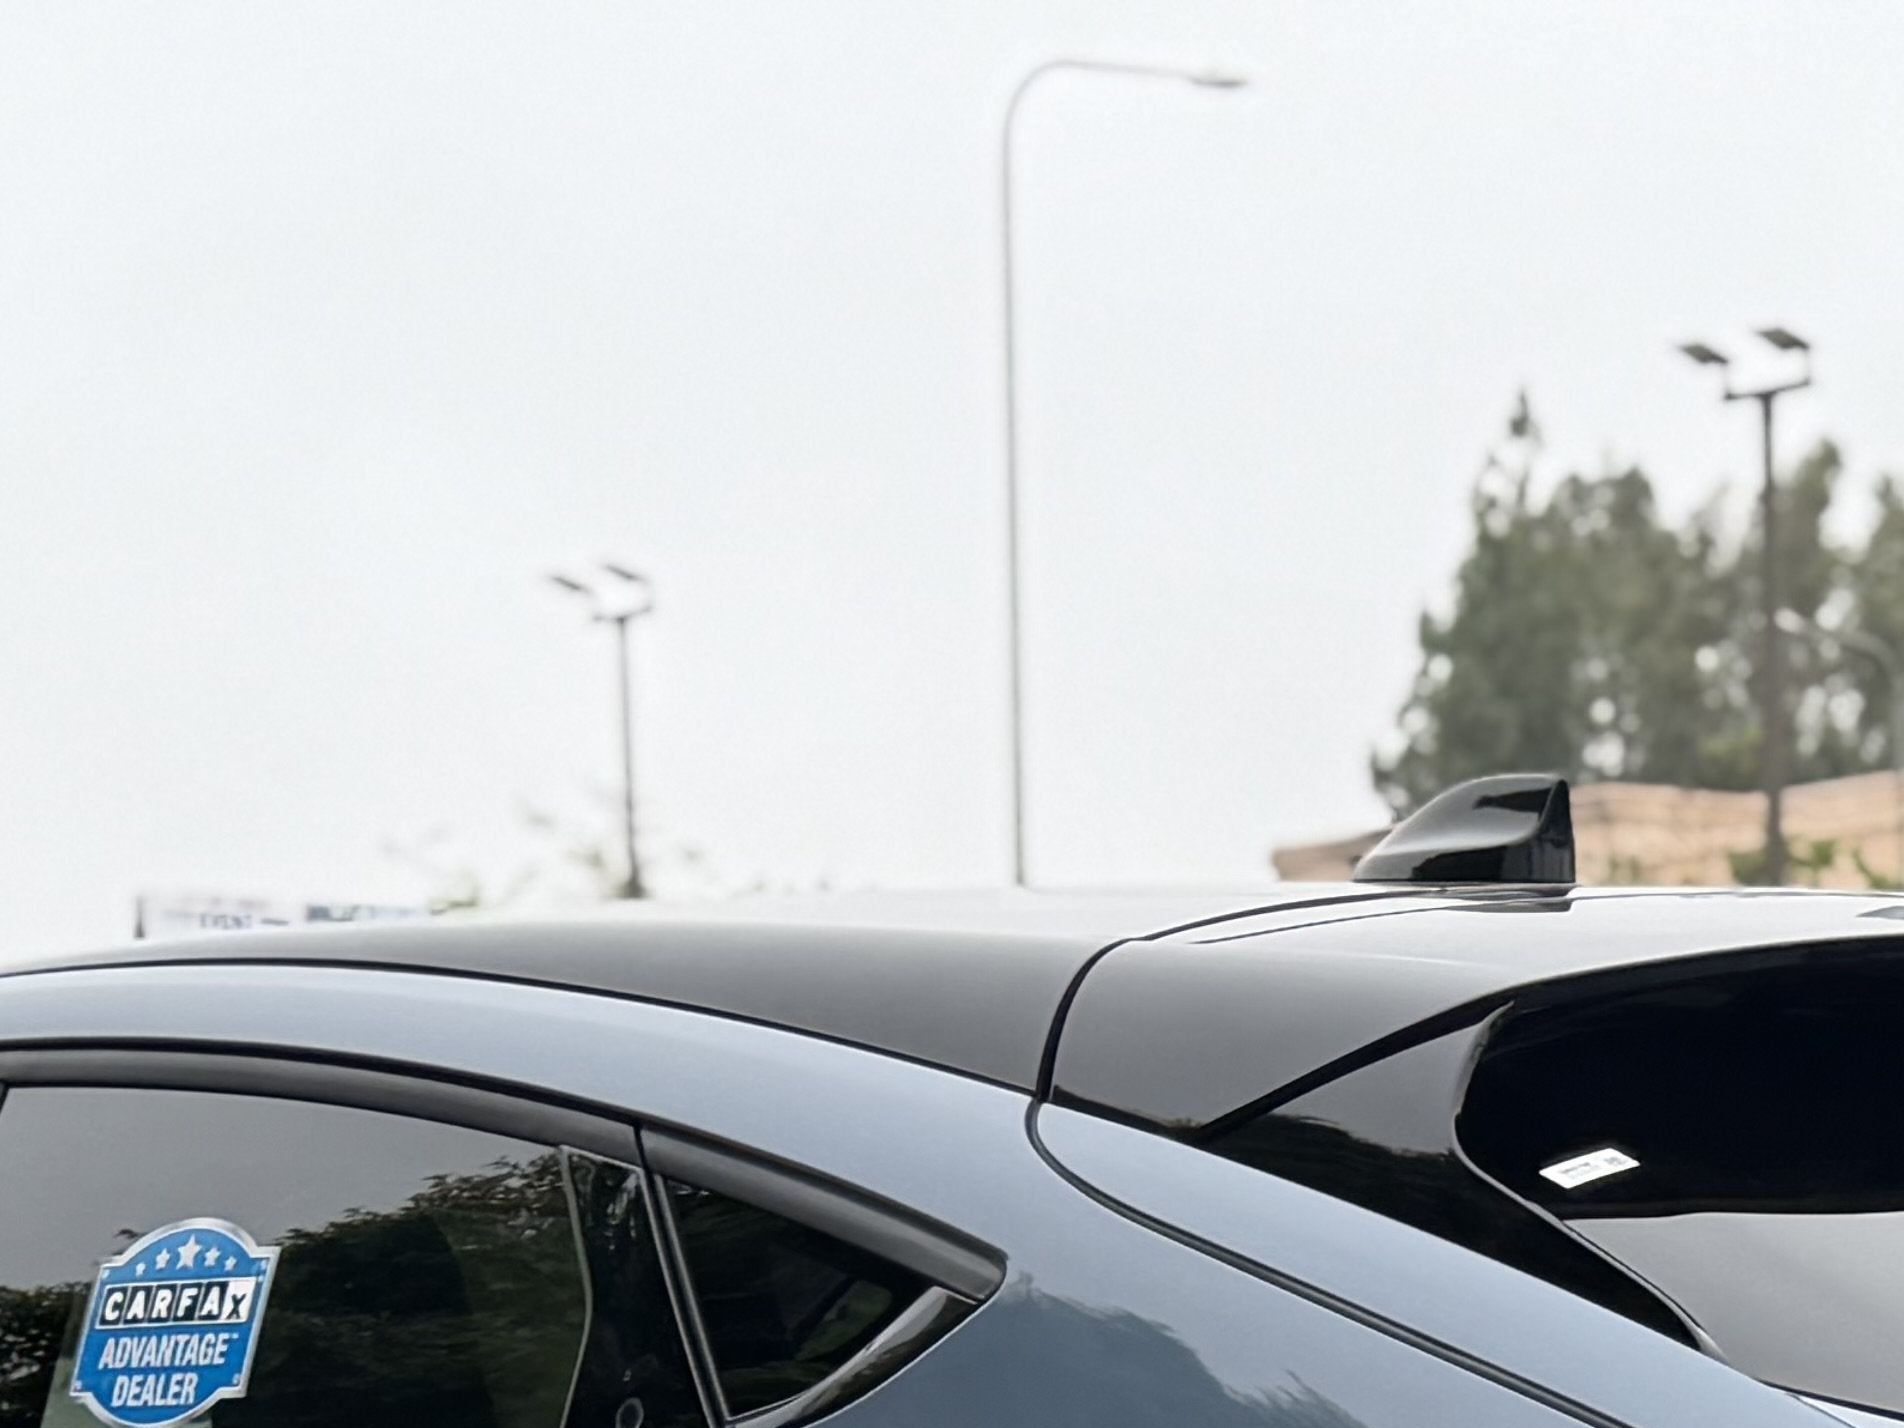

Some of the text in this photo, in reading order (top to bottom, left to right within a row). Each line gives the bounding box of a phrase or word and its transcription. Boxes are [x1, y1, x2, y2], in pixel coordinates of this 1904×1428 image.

[104, 1285, 247, 1321] CARFAX
[98, 1332, 230, 1370] ADVANTAGE
[110, 1372, 199, 1408] DEALER
